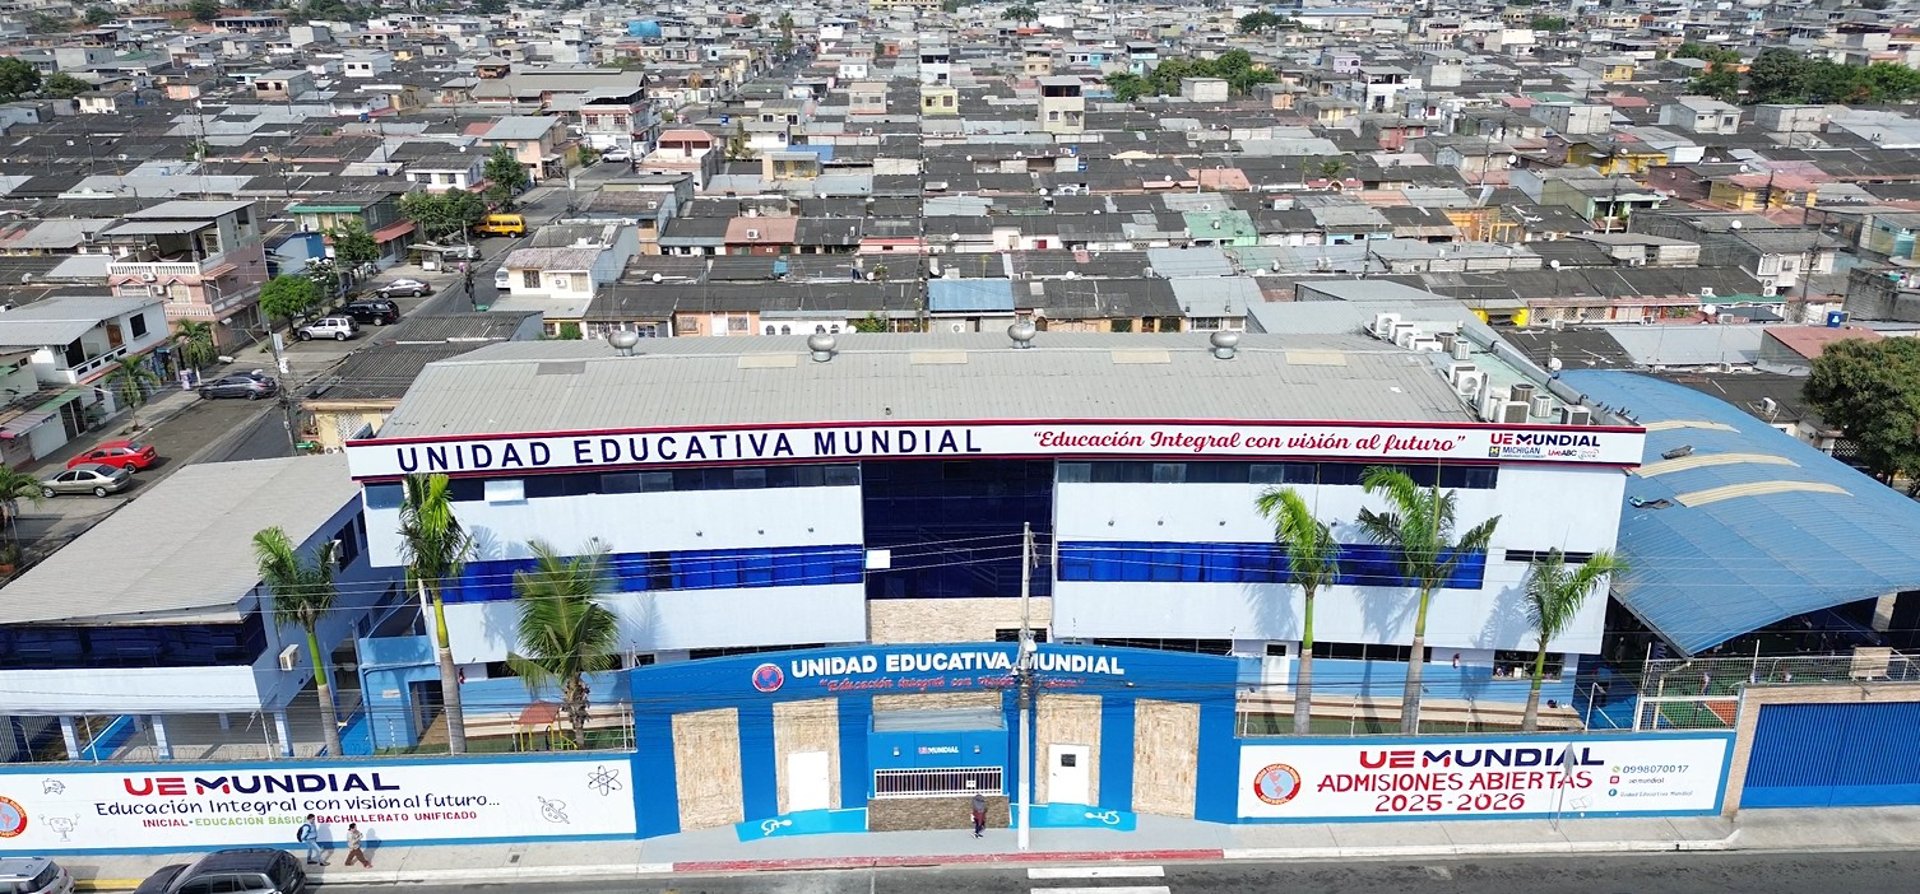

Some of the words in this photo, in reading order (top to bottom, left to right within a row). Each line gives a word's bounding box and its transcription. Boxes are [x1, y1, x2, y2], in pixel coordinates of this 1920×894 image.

[396, 440, 551, 474] UNIDAD
[573, 431, 795, 465] EDUCATIVA
[813, 427, 983, 456] MUNDIAL
[1149, 431, 1241, 453] Integral
[1244, 436, 1282, 450] con
[1287, 432, 1351, 451] visión
[1356, 432, 1381, 451] al
[1490, 433, 1514, 445] UE
[1516, 433, 1601, 447] MUNDIAL
[1503, 446, 1541, 454] MICHIGAN
[791, 655, 877, 678] UNIDAD
[885, 651, 1012, 674] EDUCATIVA
[1360, 750, 1416, 769] UE
[1423, 747, 1604, 768] MUNDIAL
[1622, 764, 1689, 774] 0998070017
[123, 777, 188, 797] UE
[194, 773, 400, 796] MUNDIAL
[1317, 772, 1463, 793] ADMISIONES
[1468, 770, 1593, 791] ABIERTAS
[95, 798, 203, 816] Educación
[209, 798, 297, 816] Integral
[303, 799, 341, 811] con
[345, 795, 400, 810] visión
[404, 795, 420, 808] al
[425, 792, 500, 808] futuro...
[317, 813, 409, 824] BACHILLERATO
[414, 811, 477, 821] UNIFICADO
